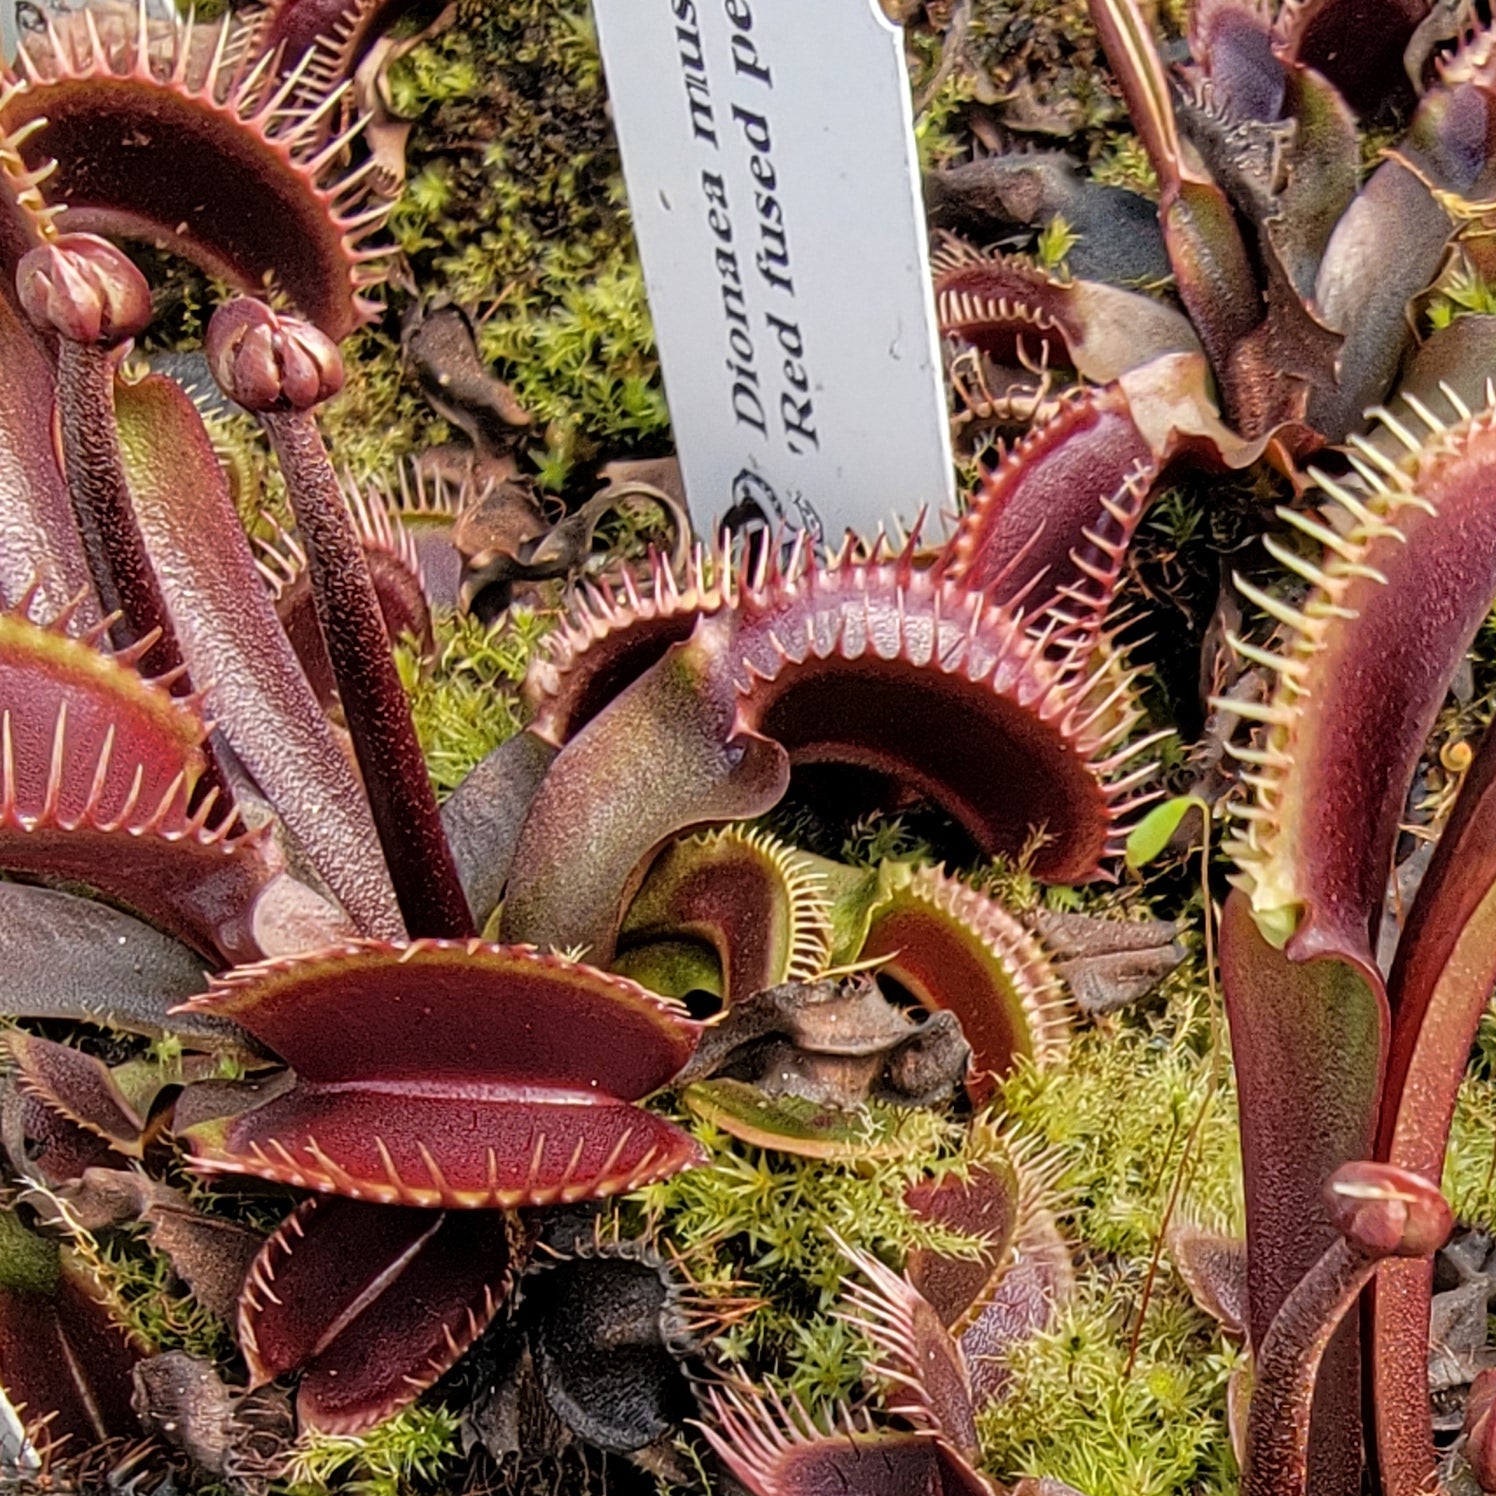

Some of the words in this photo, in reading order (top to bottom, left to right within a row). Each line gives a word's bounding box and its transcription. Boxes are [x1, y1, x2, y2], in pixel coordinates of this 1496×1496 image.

[725, 0, 773, 89] pe
[730, 102, 795, 298] fused
[702, 169, 768, 441] Dionaea
[764, 312, 820, 455] 'Red
